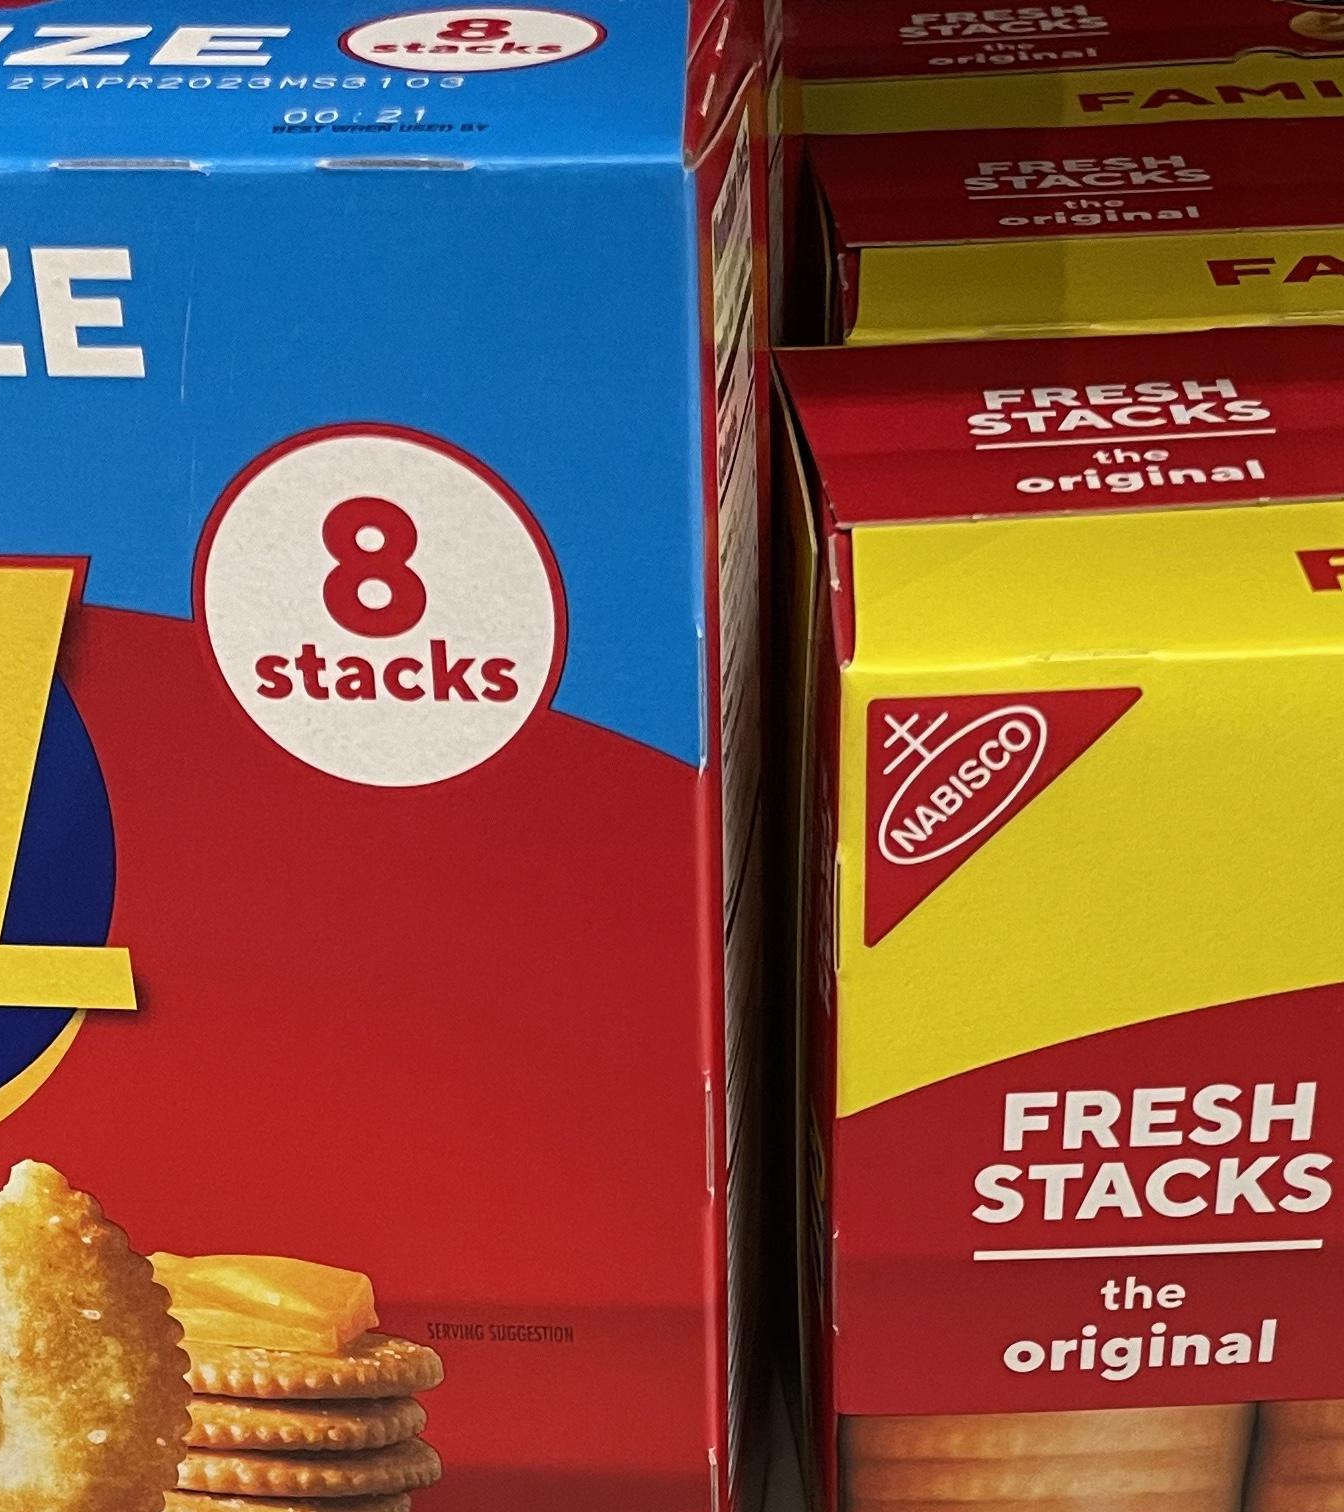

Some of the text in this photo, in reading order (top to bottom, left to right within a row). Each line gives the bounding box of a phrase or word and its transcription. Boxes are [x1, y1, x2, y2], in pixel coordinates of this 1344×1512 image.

[436, 18, 513, 43] 8
[899, 15, 1109, 39] STACKS
[911, 6, 1088, 26] FRESH
[371, 40, 563, 56] stacks
[929, 48, 1097, 66] original
[964, 168, 1212, 193] STACKS
[979, 155, 1187, 178] FRESH
[998, 205, 1200, 228] original
[982, 379, 1239, 412] FRESH
[968, 399, 1273, 437] STACKS
[1093, 447, 1170, 465] the
[1015, 459, 1266, 497] original
[321, 497, 428, 639] 8
[254, 642, 519, 704] stacks
[890, 722, 1033, 855] NABISCO
[1002, 1081, 1318, 1152] FRESH
[972, 1152, 1334, 1223] STACKS
[1100, 1276, 1186, 1310] the
[426, 1322, 575, 1345] SERVING SUGGESTION
[1003, 1319, 1276, 1381] original
